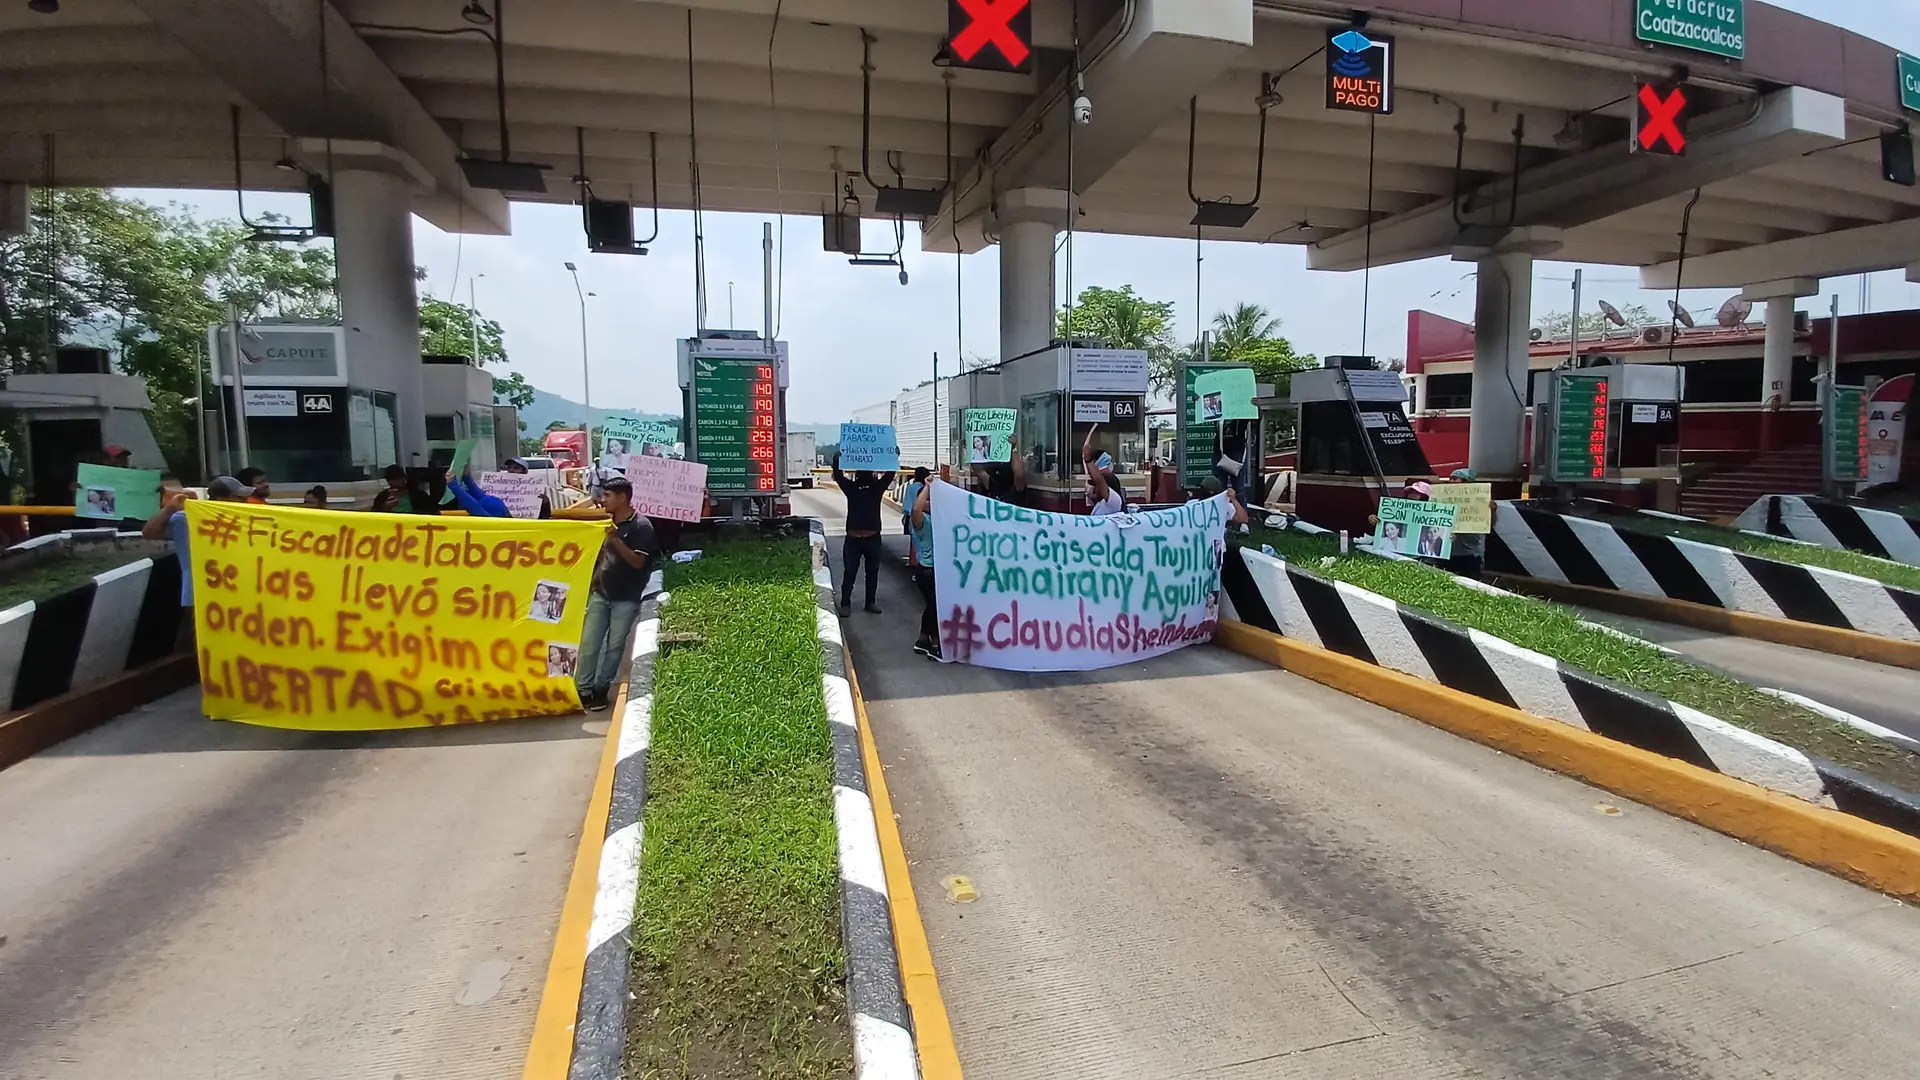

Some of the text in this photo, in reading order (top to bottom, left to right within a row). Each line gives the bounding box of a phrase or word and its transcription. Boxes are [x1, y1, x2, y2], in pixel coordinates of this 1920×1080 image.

[1653, 0, 1736, 23] eracruz
[1640, 9, 1743, 50] Coatzacoalcos
[1336, 91, 1379, 108] PAGO
[266, 347, 328, 359] CAPUFE
[758, 367, 772, 379] 70
[755, 383, 772, 395] 140
[305, 397, 331, 410] 4A
[756, 399, 773, 411] 190
[1115, 403, 1133, 415] 6A
[966, 410, 987, 422] igimos
[1384, 412, 1400, 421] 7A
[1660, 409, 1672, 420] 8A
[619, 418, 666, 434] JUSTICIA
[756, 415, 773, 427] 178
[752, 431, 773, 442] 253
[842, 433, 877, 443] TABASCO
[752, 446, 774, 458] 266
[760, 462, 774, 474] 70
[760, 478, 774, 489] 89
[1381, 497, 1422, 512] Exigimos
[634, 502, 697, 522] OCENTES
[1381, 507, 1407, 521] SON
[1411, 512, 1453, 527] INOCENTES
[952, 523, 1029, 562] Para:
[1033, 527, 1144, 577] Griselda
[205, 556, 516, 620] se las llevó sin
[980, 557, 1135, 614] Amairany
[206, 601, 325, 650] orden.
[942, 595, 1217, 664] #ClaudiaSheinbau
[202, 646, 423, 720] LIBERTAD
